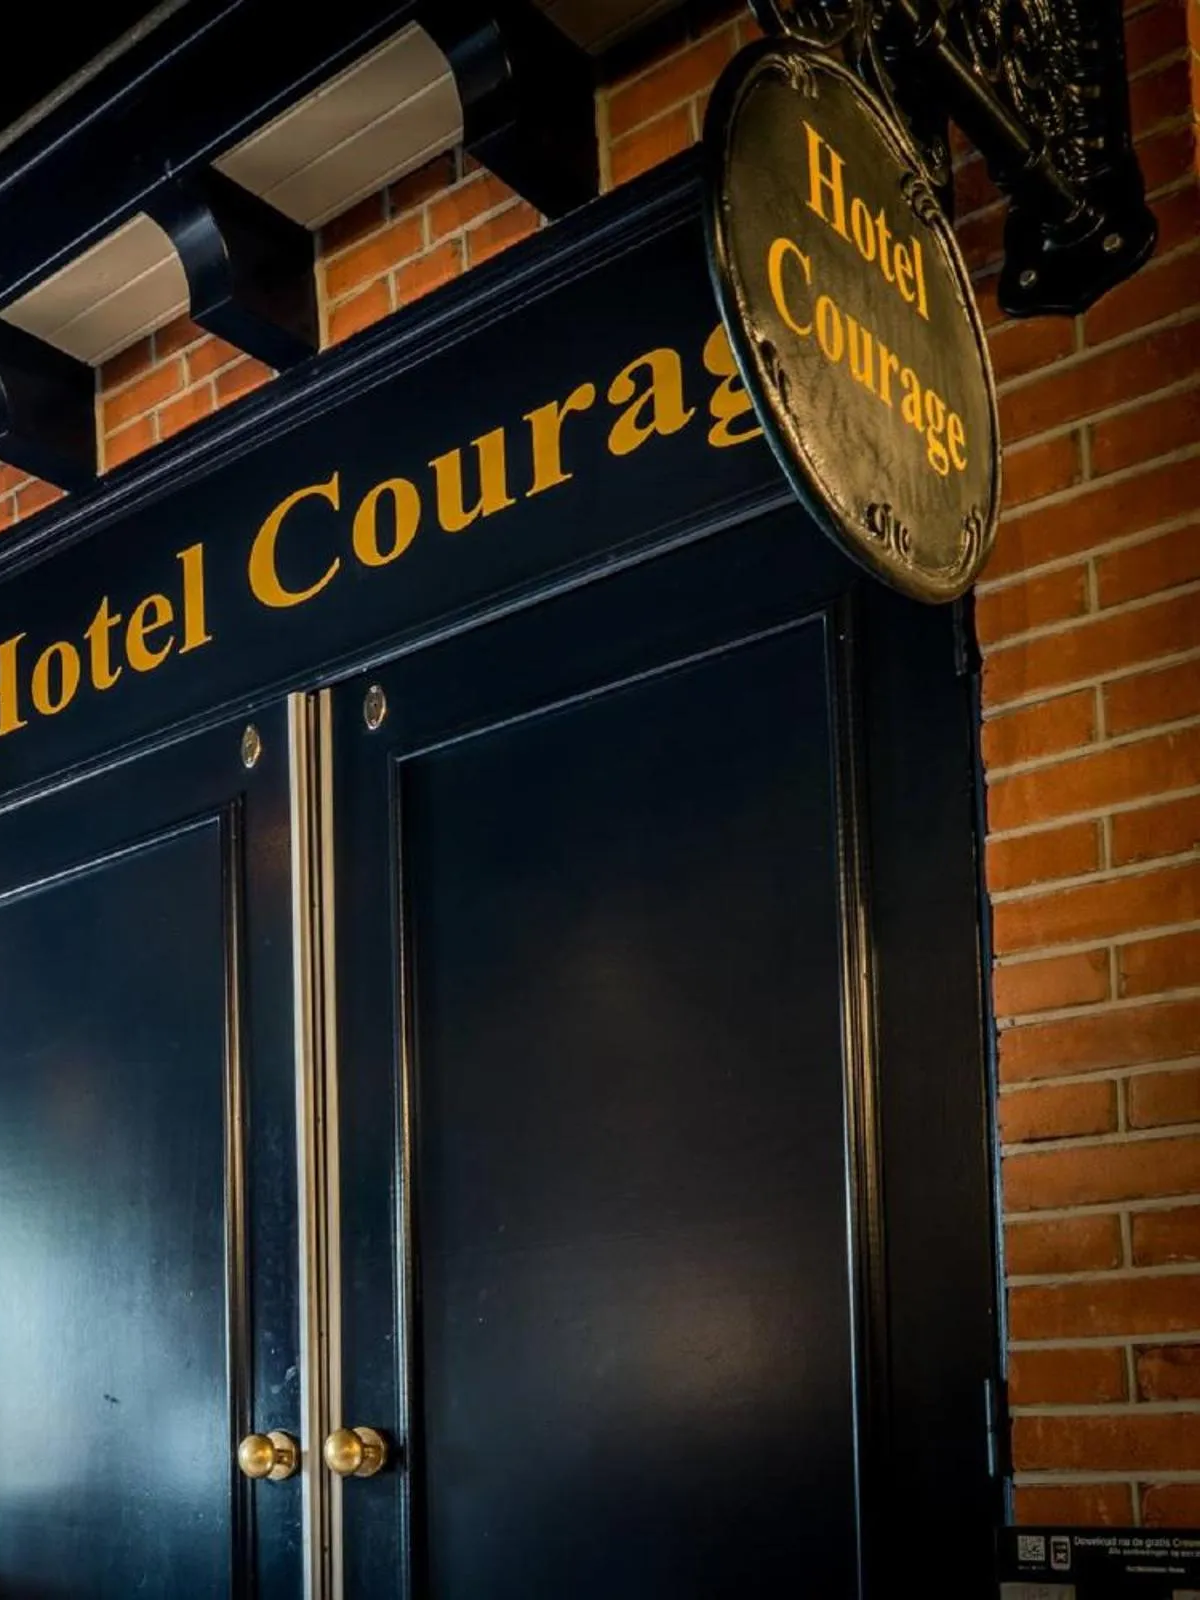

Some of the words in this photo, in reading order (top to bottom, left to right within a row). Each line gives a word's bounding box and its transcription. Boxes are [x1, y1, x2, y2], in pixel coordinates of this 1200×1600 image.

[803, 121, 930, 321] Hotel
[247, 322, 765, 608] Courag
[767, 237, 968, 477] Courage
